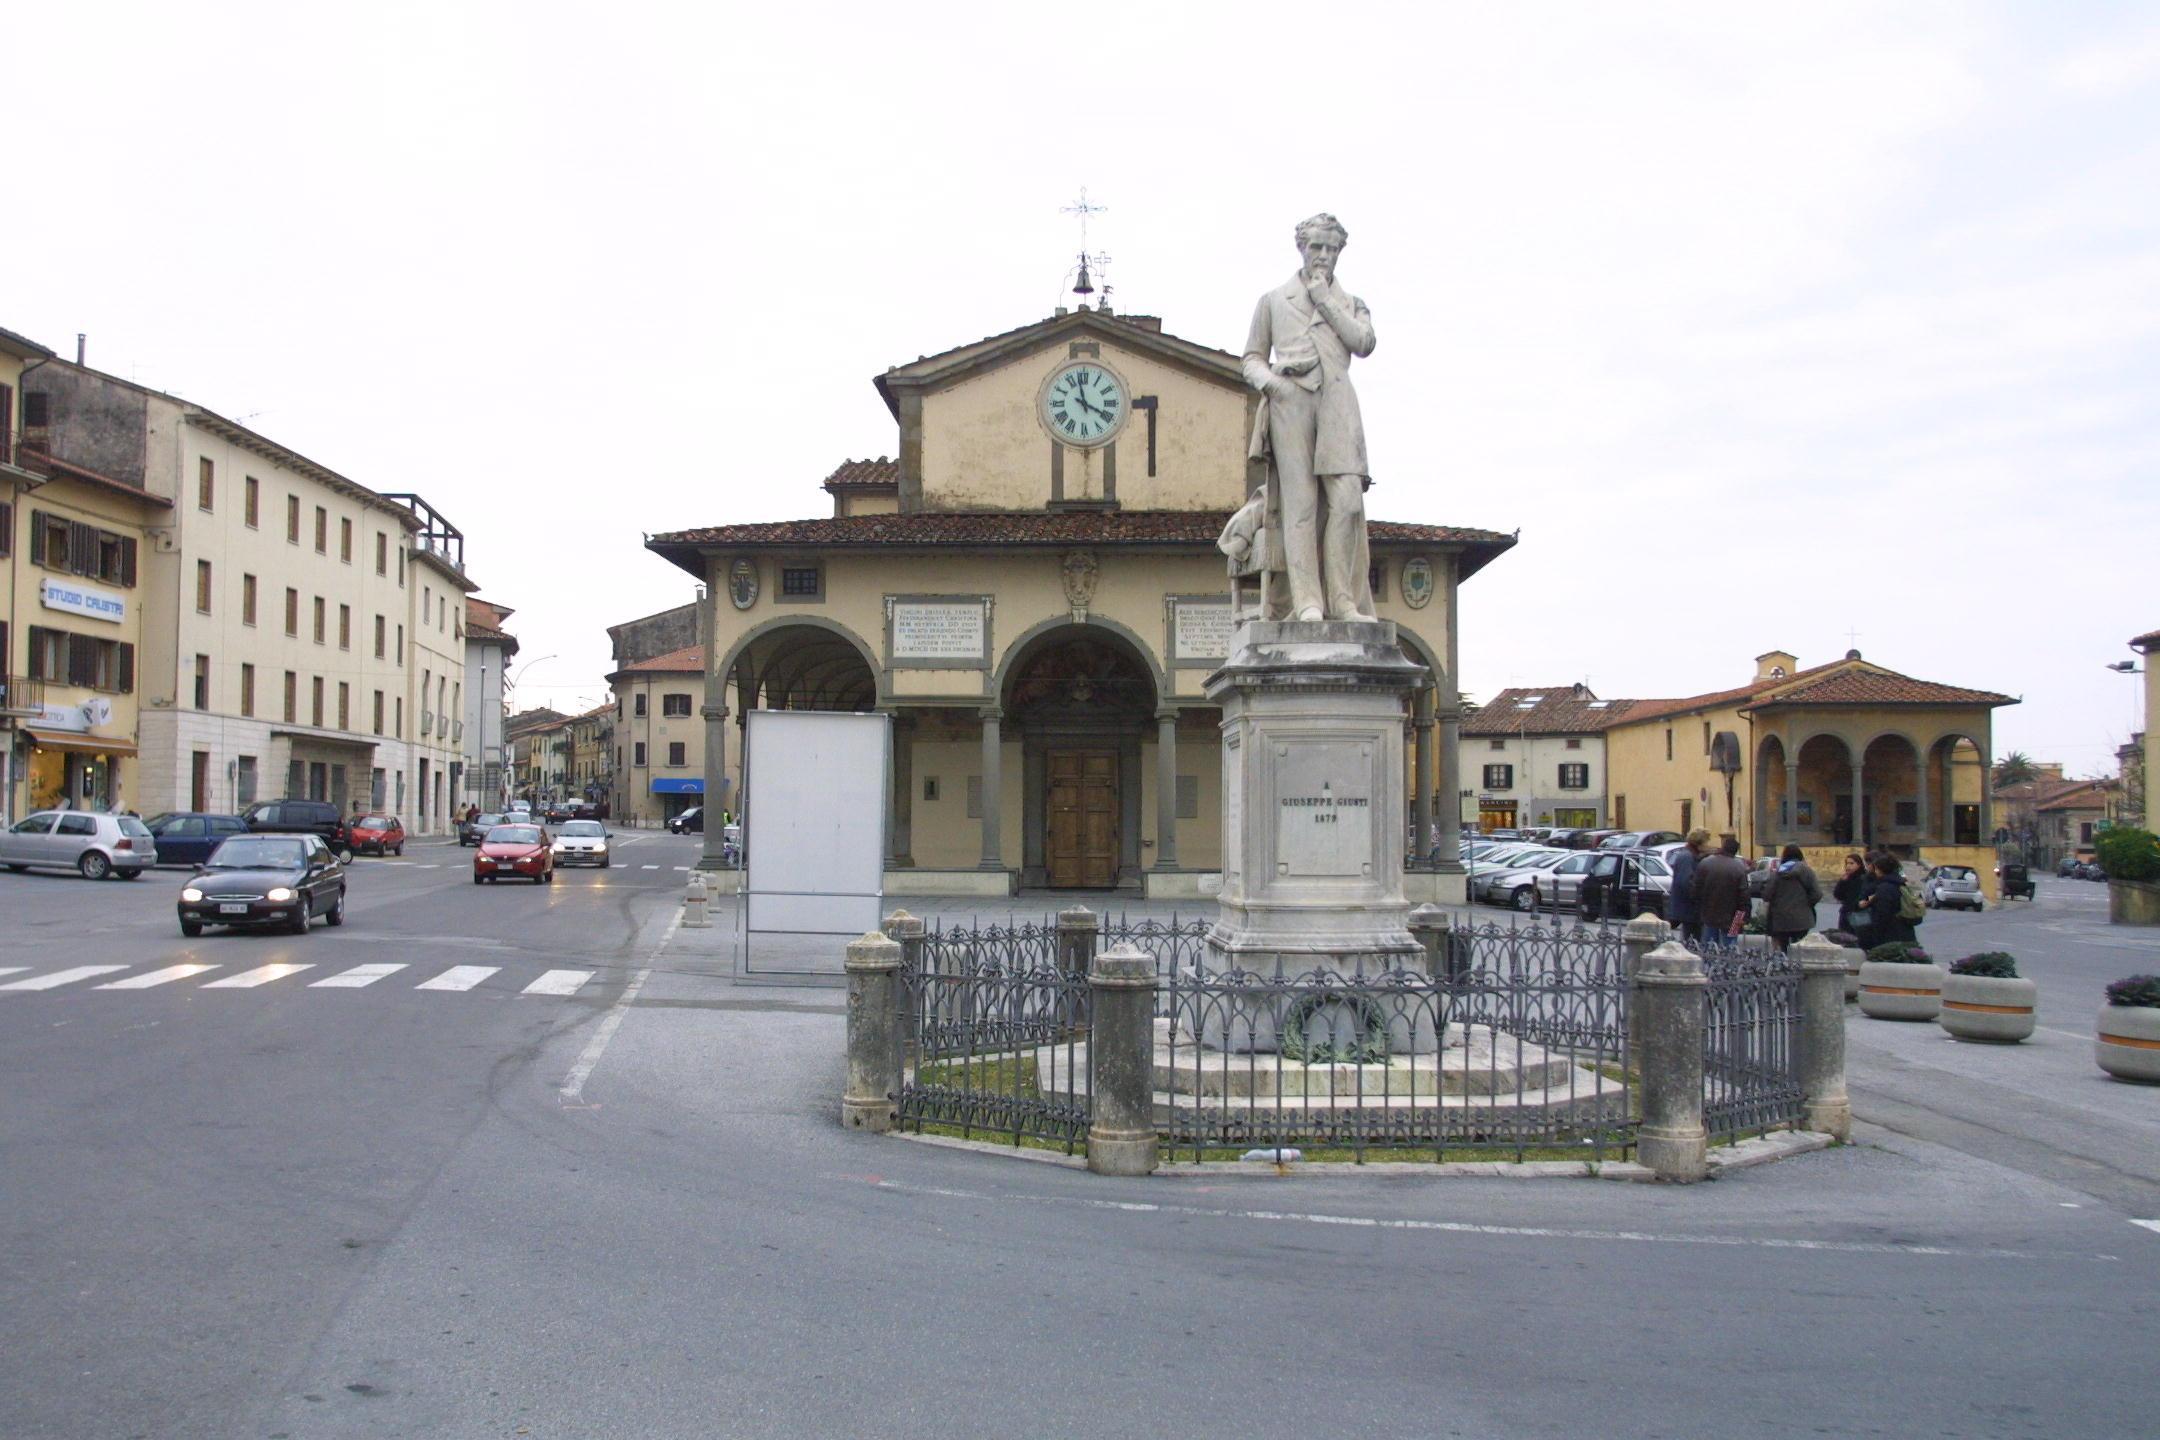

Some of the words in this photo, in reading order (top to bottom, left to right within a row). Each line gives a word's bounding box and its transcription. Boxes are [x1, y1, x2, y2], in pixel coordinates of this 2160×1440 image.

[47, 587, 82, 605] STUDIO
[1324, 782, 1330, 790] A
[1282, 798, 1332, 806] GIUSEPPE
[1337, 798, 1368, 806] GIUSTI
